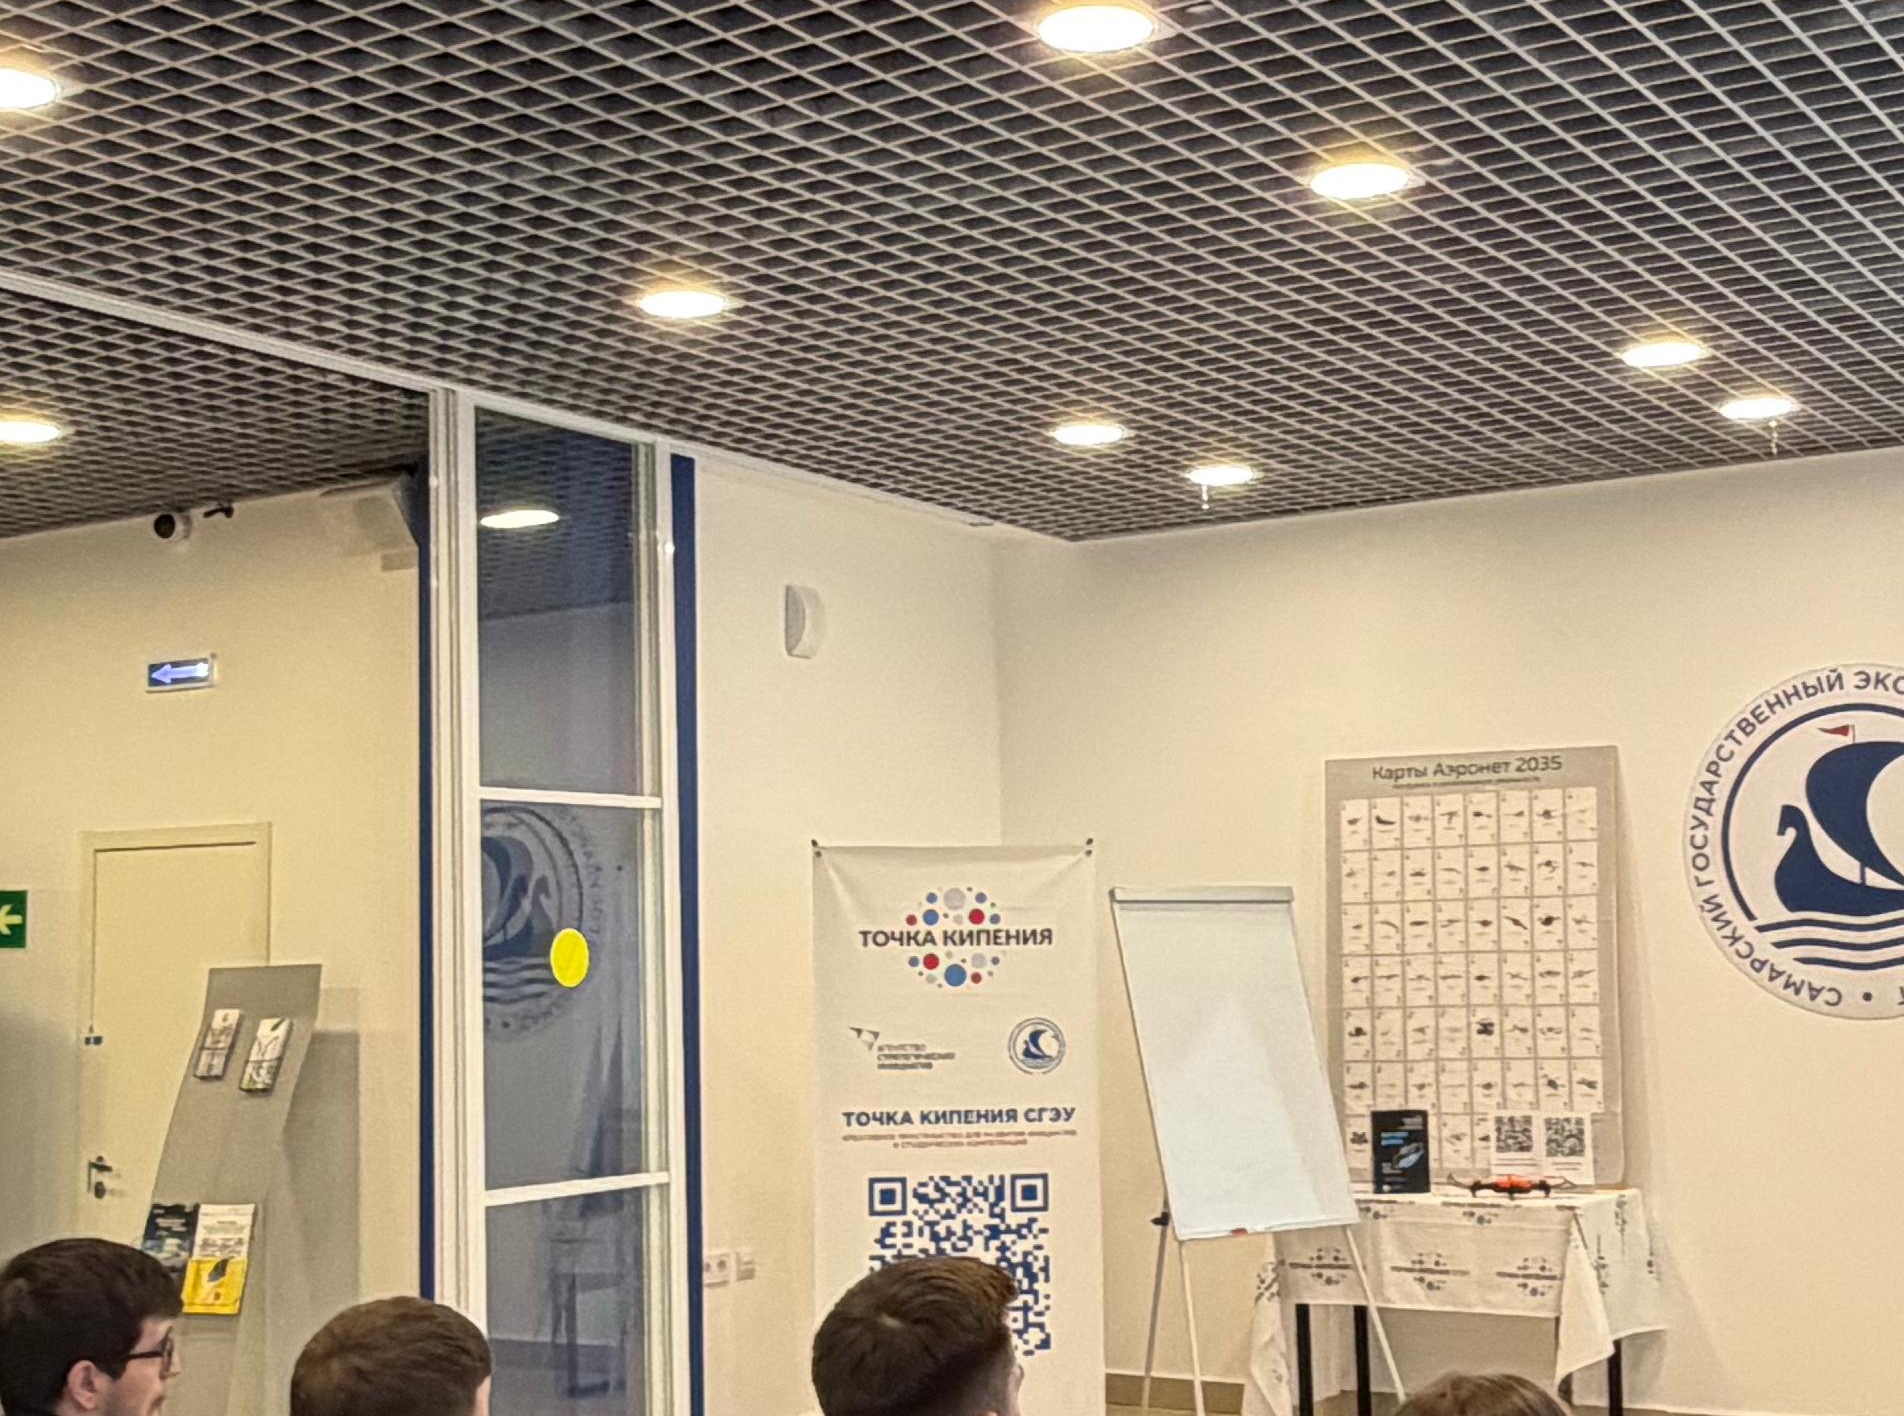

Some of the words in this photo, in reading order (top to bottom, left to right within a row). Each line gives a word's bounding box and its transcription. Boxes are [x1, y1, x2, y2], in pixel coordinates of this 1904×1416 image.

[1372, 766, 1428, 782] Карты
[1433, 761, 1512, 779] Аэронет
[1515, 755, 1563, 772] 2035
[1689, 668, 1845, 887] ГОСУДАРСТВЕННЫЙ
[858, 929, 938, 948] ТОЧКА
[942, 927, 1054, 947] КИПЕНИЯ
[1699, 893, 1843, 1007] САМАРСКИЙ
[842, 1110, 914, 1127] ТОЧКА
[919, 1108, 1018, 1125] КИПЕНИЯ
[1023, 1106, 1076, 1123] СГЭУ
